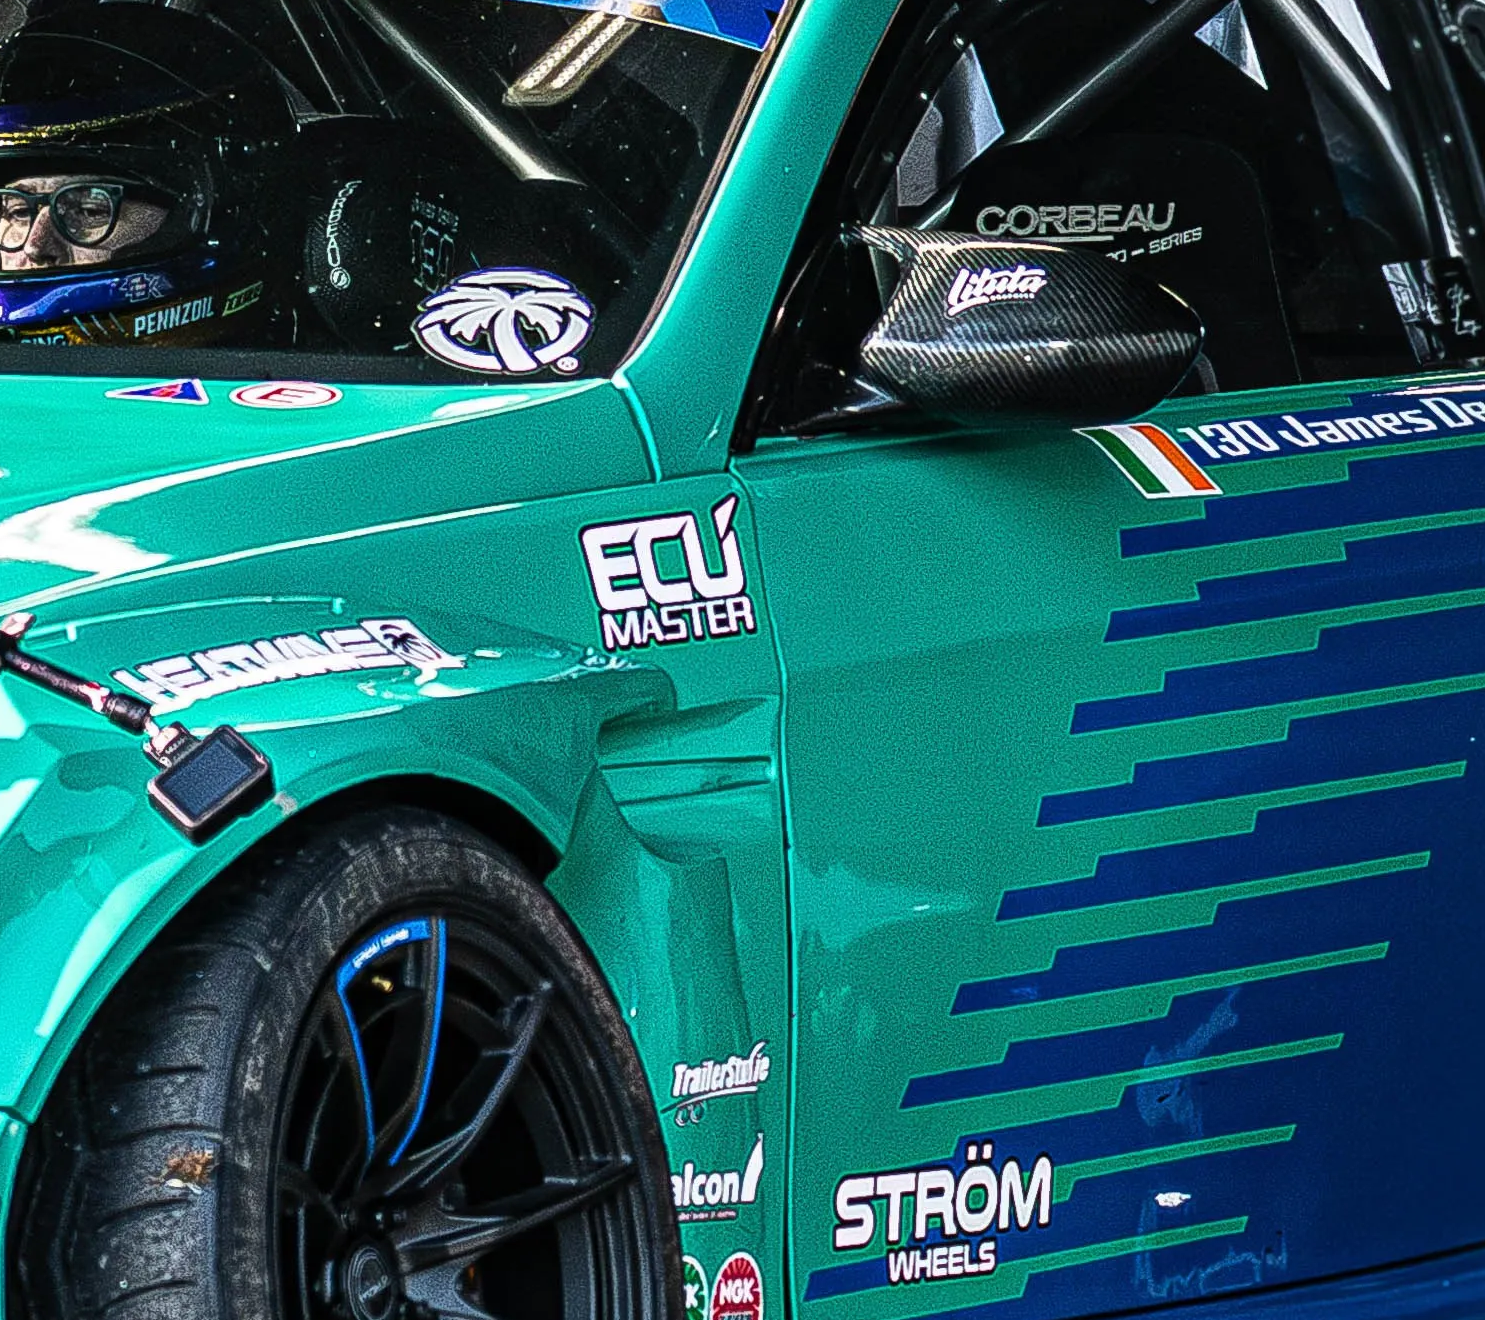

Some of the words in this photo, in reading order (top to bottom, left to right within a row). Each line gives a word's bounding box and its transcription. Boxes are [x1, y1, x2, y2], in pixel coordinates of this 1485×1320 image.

[975, 202, 1176, 237] CORBEAU
[1149, 227, 1203, 255] SERIES
[133, 296, 215, 338] PENNZOIL
[1177, 421, 1280, 460] 130
[1278, 409, 1438, 448] James
[601, 597, 756, 650] MASTER
[670, 1163, 741, 1207] alcon
[834, 1143, 1053, 1248] STRÖM
[889, 1241, 996, 1282] WHEELS
[719, 1278, 755, 1306] NGK
